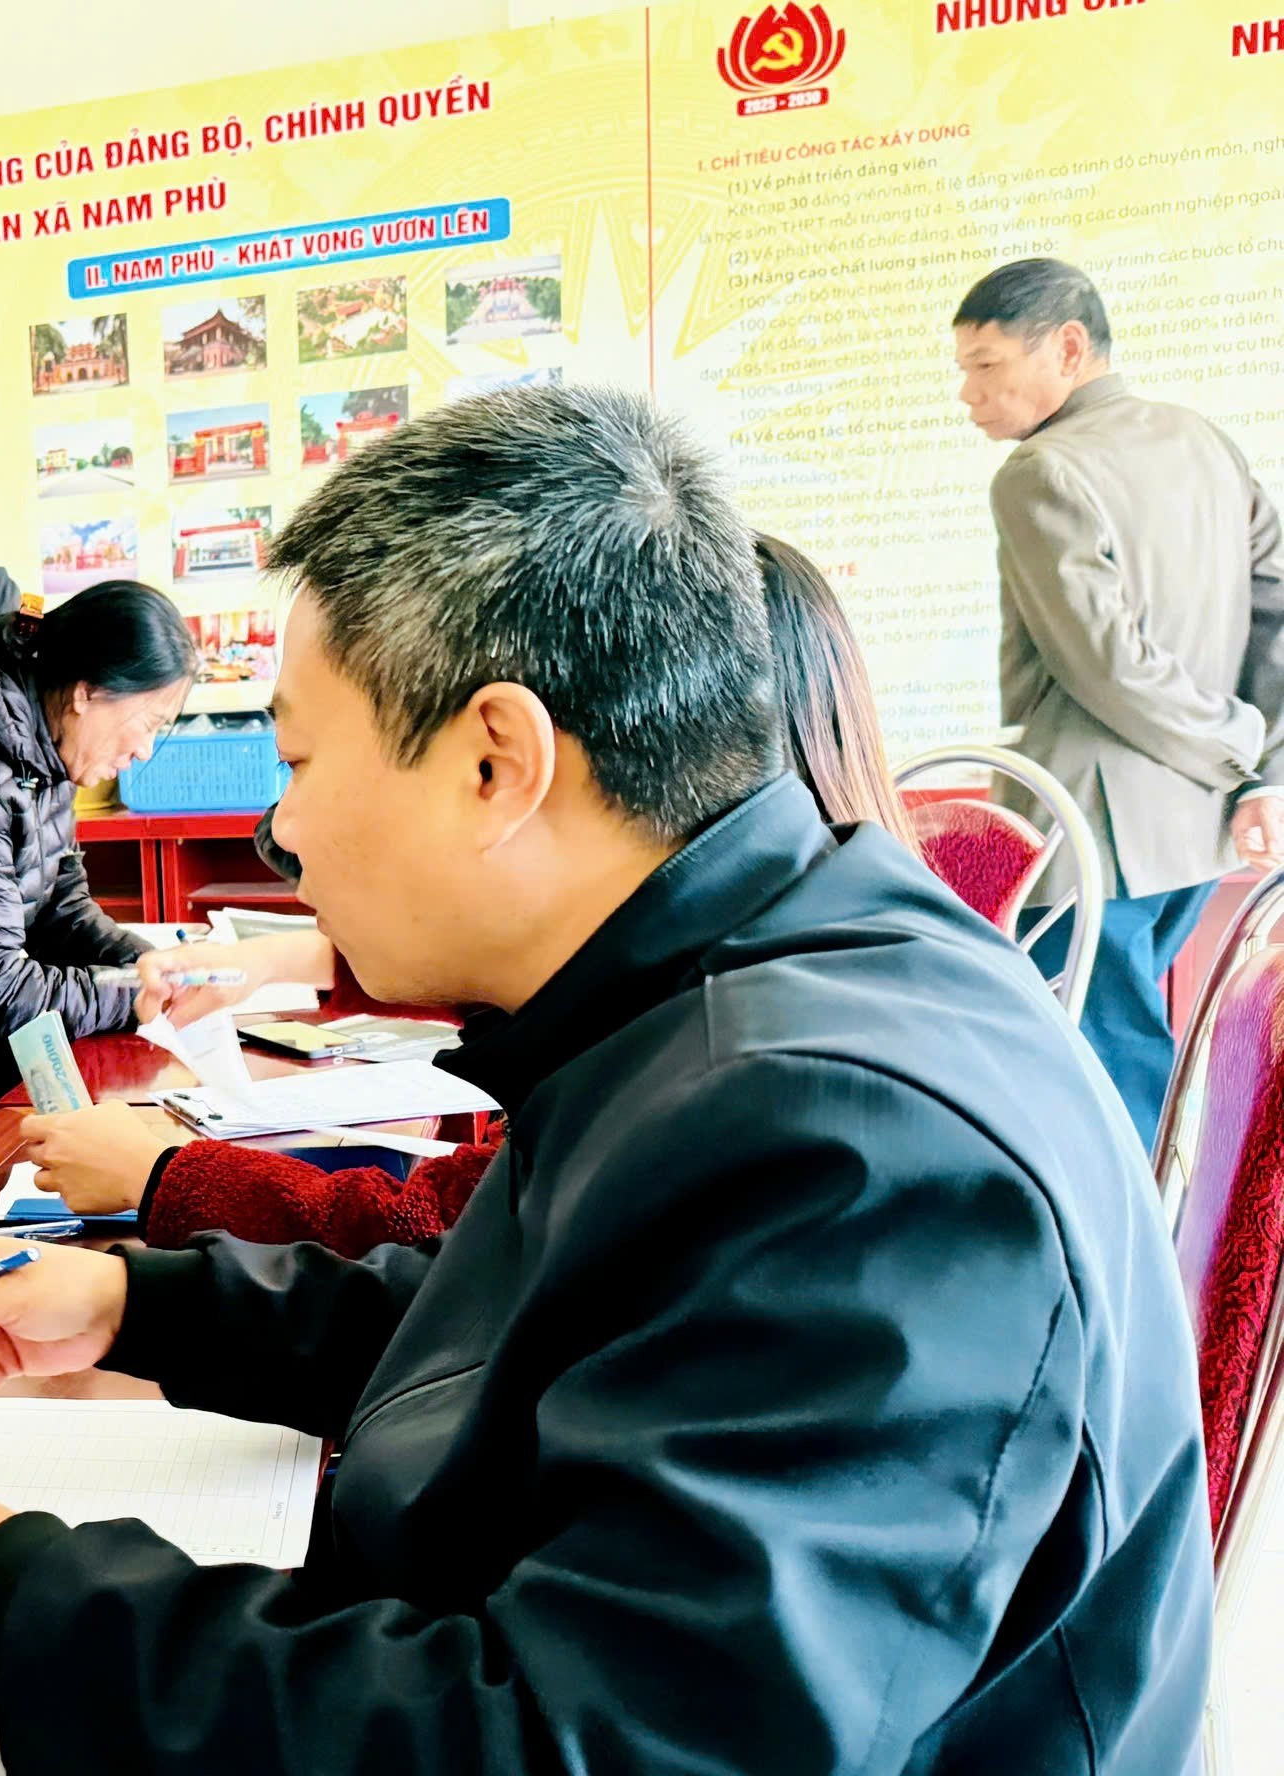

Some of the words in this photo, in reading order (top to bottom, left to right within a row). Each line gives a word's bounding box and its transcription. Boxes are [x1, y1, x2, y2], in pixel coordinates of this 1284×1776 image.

[744, 95, 776, 114] 2025
[788, 89, 822, 108] 2030
[34, 142, 95, 180] CỦA
[105, 129, 189, 169] ĐẢNG
[201, 118, 253, 155] BỘ,
[265, 101, 365, 143] CHÍNH
[378, 76, 491, 128] QUYỀN
[786, 143, 835, 160] CÔNG
[790, 194, 808, 209] 30
[1138, 147, 1202, 166] chuyên
[34, 206, 71, 236] XÃ
[83, 193, 152, 229] NAM
[164, 178, 227, 217] PHÙ
[1038, 214, 1082, 227] trong
[1118, 200, 1172, 218] doanh
[87, 268, 107, 288] II.
[114, 258, 163, 282] NAM
[170, 246, 215, 275] PHÙ
[237, 236, 294, 265] KHÁT
[302, 227, 365, 260] VỌNG
[372, 218, 435, 245] VƯƠN
[443, 207, 489, 237] LÊN
[798, 267, 828, 278] cao
[920, 248, 956, 264] sinh
[1224, 291, 1266, 307] quan
[740, 317, 766, 331] 100
